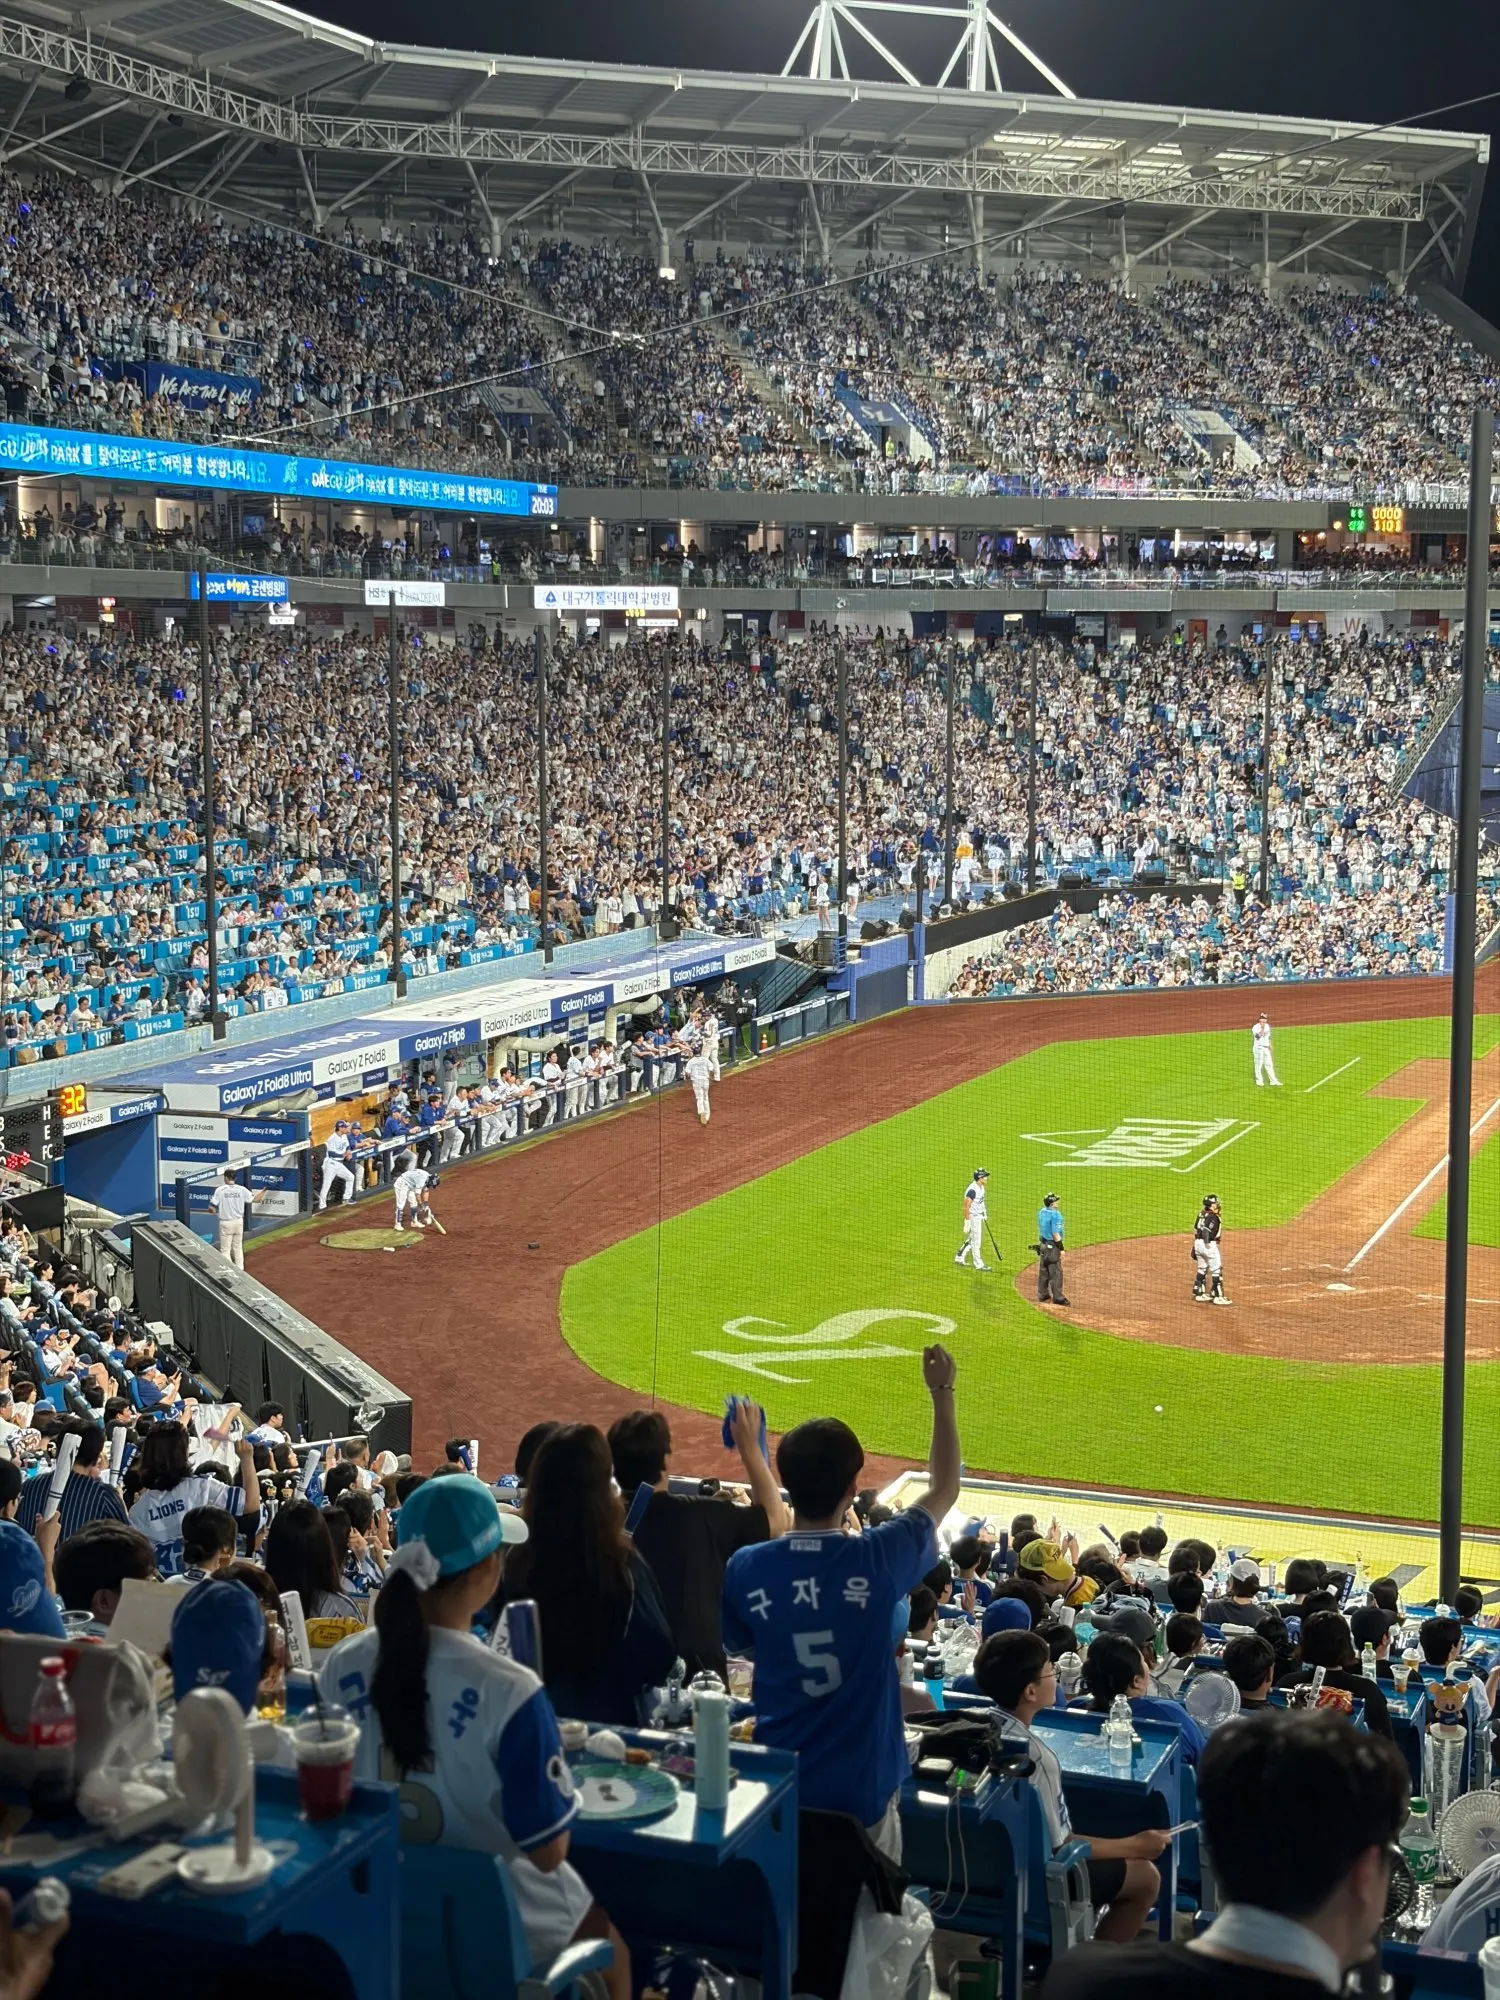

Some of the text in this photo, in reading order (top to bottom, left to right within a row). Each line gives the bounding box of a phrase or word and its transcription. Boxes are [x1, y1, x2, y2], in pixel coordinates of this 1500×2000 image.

[532, 496, 554, 515] 20:03
[422, 520, 433, 532] 21
[611, 525, 624, 537] 23
[790, 528, 804, 539] 25
[961, 530, 974, 541] 27
[562, 591, 671, 607] 대구가톨릭대학교병원
[734, 953, 751, 965] Galaxy
[673, 969, 693, 982] Galaxy
[624, 983, 644, 995] Galaxy
[561, 991, 605, 1012] Galaxy Z Fold8
[484, 1007, 549, 1033] Galaxy Z Fold8 Ultra
[415, 1027, 465, 1052] Galaxy Z Flip8
[328, 1049, 386, 1075] Galaxy Z Fold8
[223, 1070, 312, 1104] Galaxy Z Fold8 Ultra
[64, 1084, 85, 1114] 32
[43, 1105, 51, 1121] H
[119, 1105, 140, 1117] Galaxy
[144, 1101, 157, 1113] Flip8
[87, 1116, 103, 1126] Fold8
[174, 1123, 193, 1131] Galaxy
[44, 1125, 51, 1140] E
[243, 1127, 264, 1135] Galaxy
[269, 1128, 283, 1136] Flip8
[167, 1146, 187, 1154] Galaxy
[1043, 1118, 1239, 1167] TERRA
[42, 1143, 53, 1161] FC
[148, 1499, 185, 1521] LIONS
[747, 1577, 871, 1620] 구자욱
[792, 1630, 842, 1697] 5
